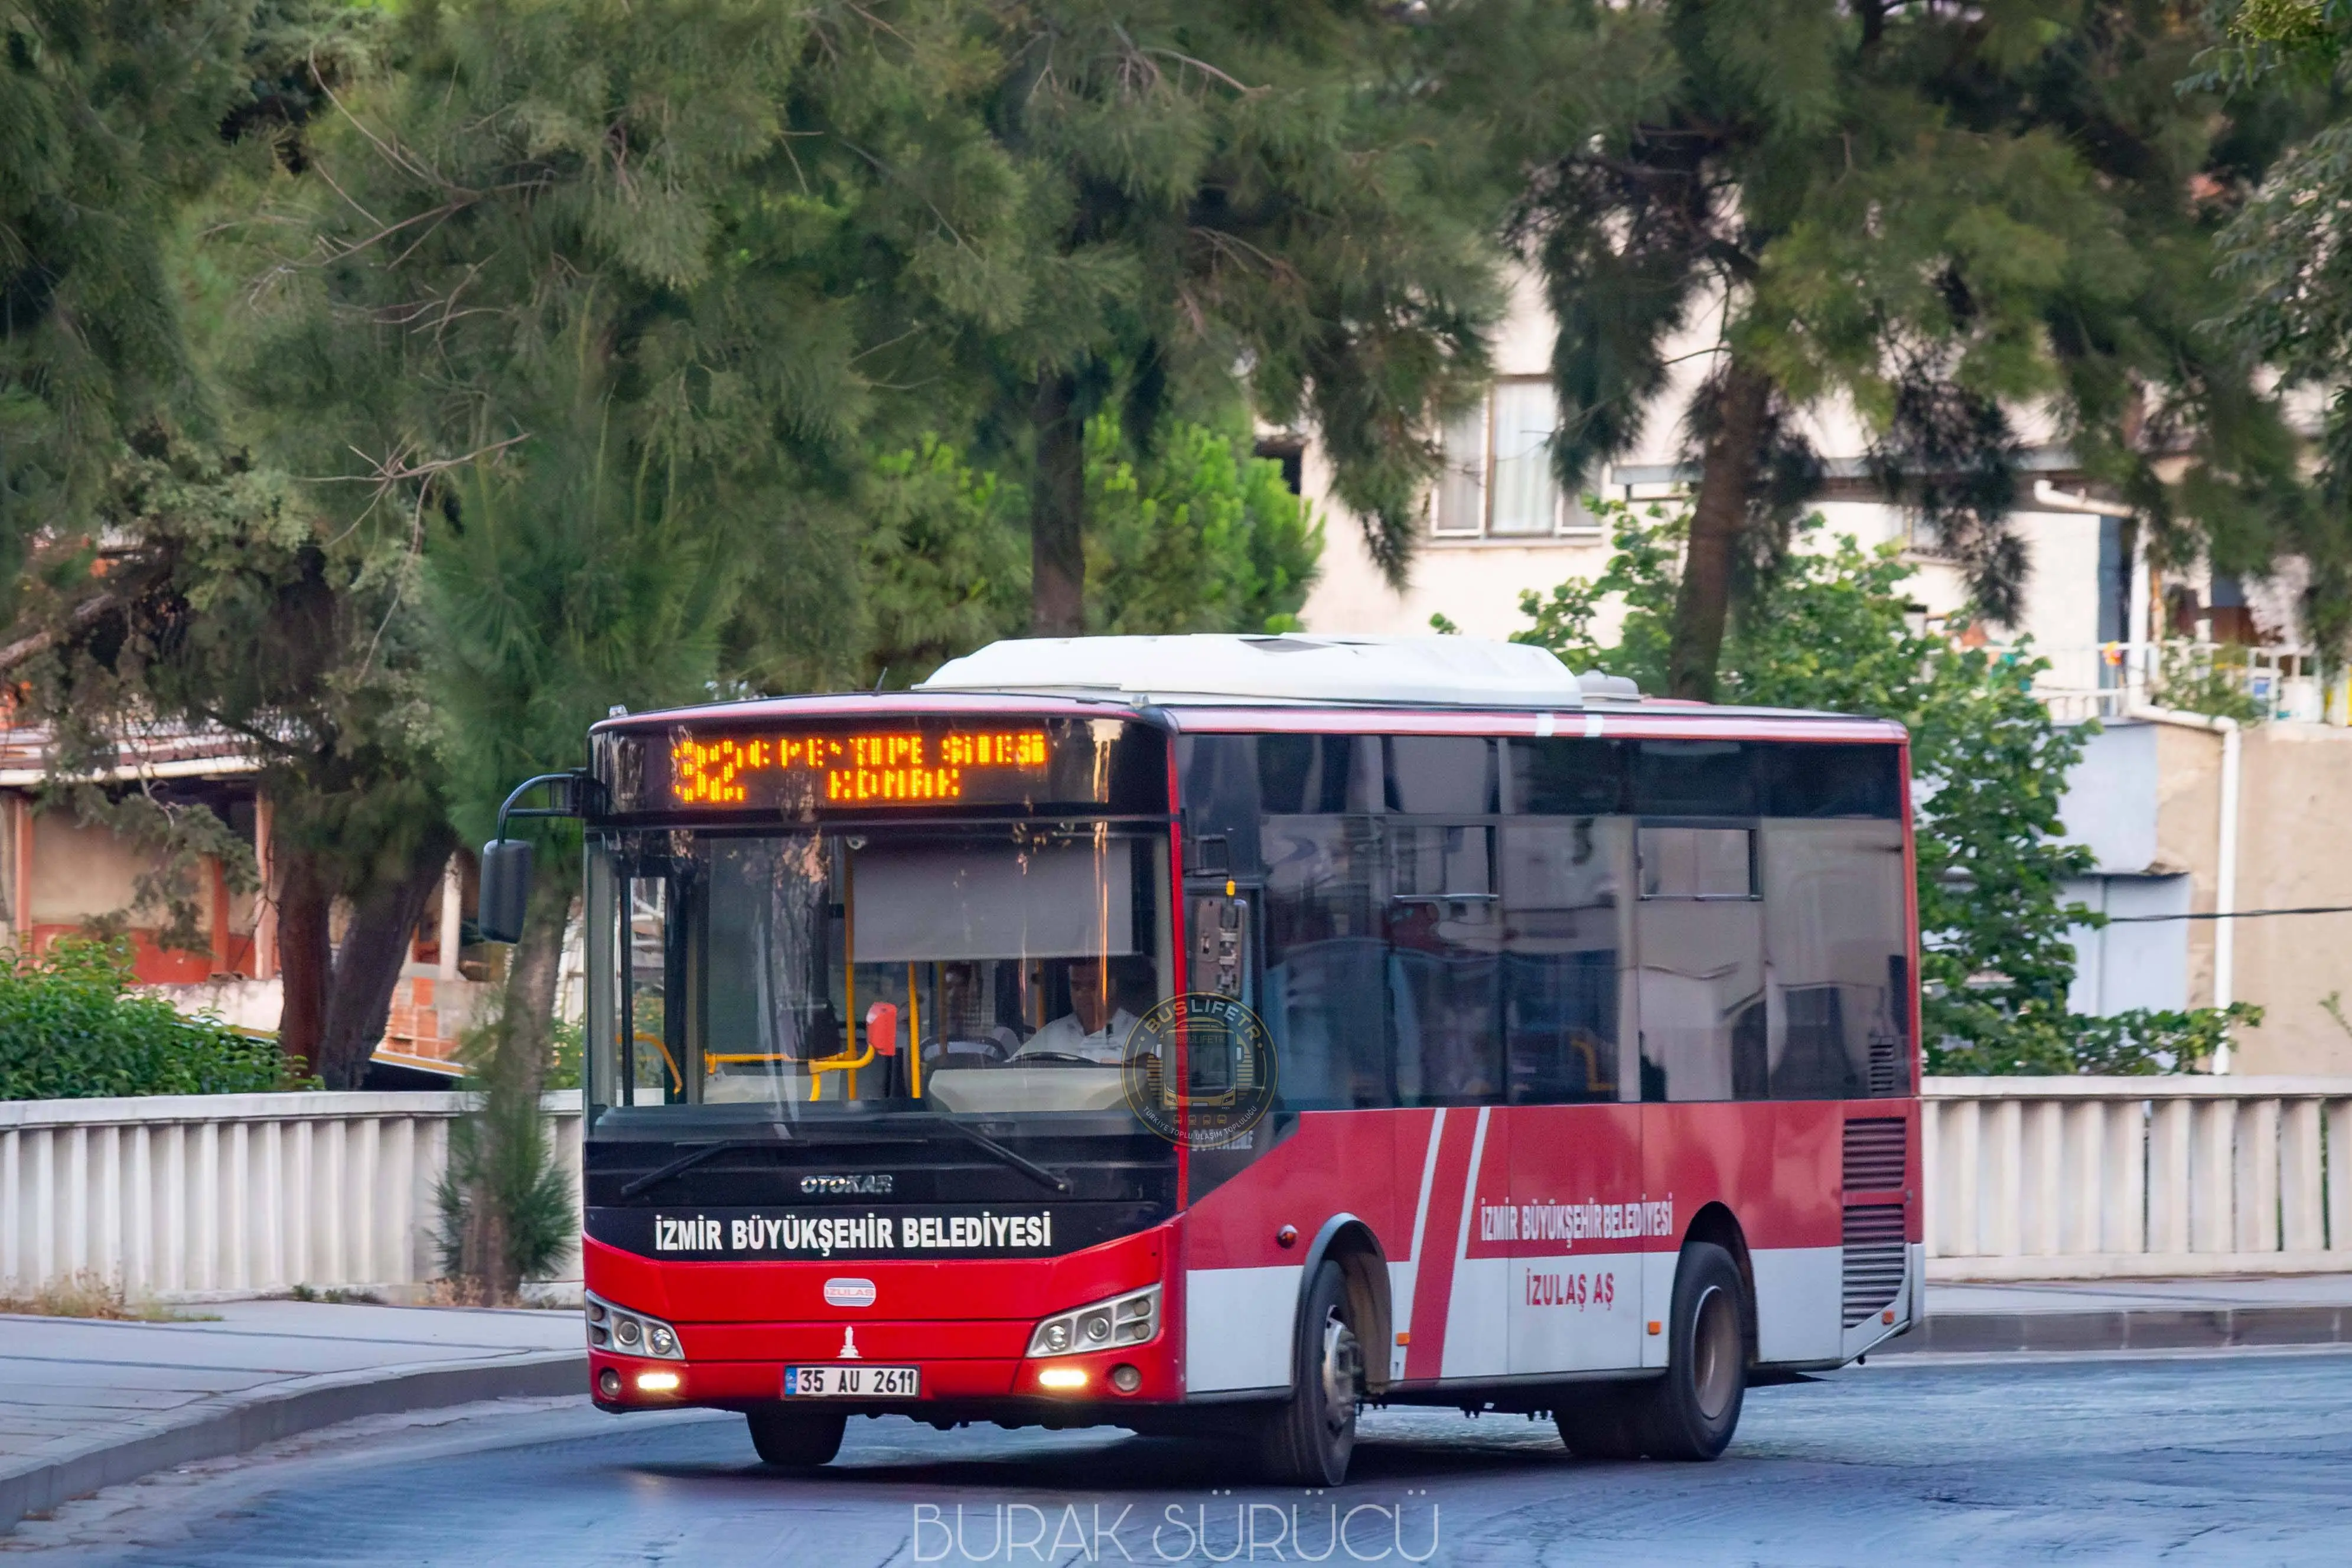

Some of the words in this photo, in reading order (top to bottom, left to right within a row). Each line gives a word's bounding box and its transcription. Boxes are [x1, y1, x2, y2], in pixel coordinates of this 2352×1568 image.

[800, 1175, 894, 1194] OTOKAR
[655, 1214, 723, 1251] İZMİR
[731, 1212, 895, 1257] BÜYÜKŞEHİR
[902, 1211, 1052, 1248] BELEDİYESİ
[1480, 1197, 1519, 1241] İZMİR
[1521, 1194, 1604, 1248] BÜYÜKŞEHİR
[1604, 1192, 1673, 1238] BELEDİYESİ
[1526, 1267, 1587, 1312] İZULAŞ
[1592, 1272, 1615, 1311] AŞ
[800, 1370, 825, 1393] 35
[838, 1370, 860, 1393] AU
[874, 1370, 914, 1393] 2611
